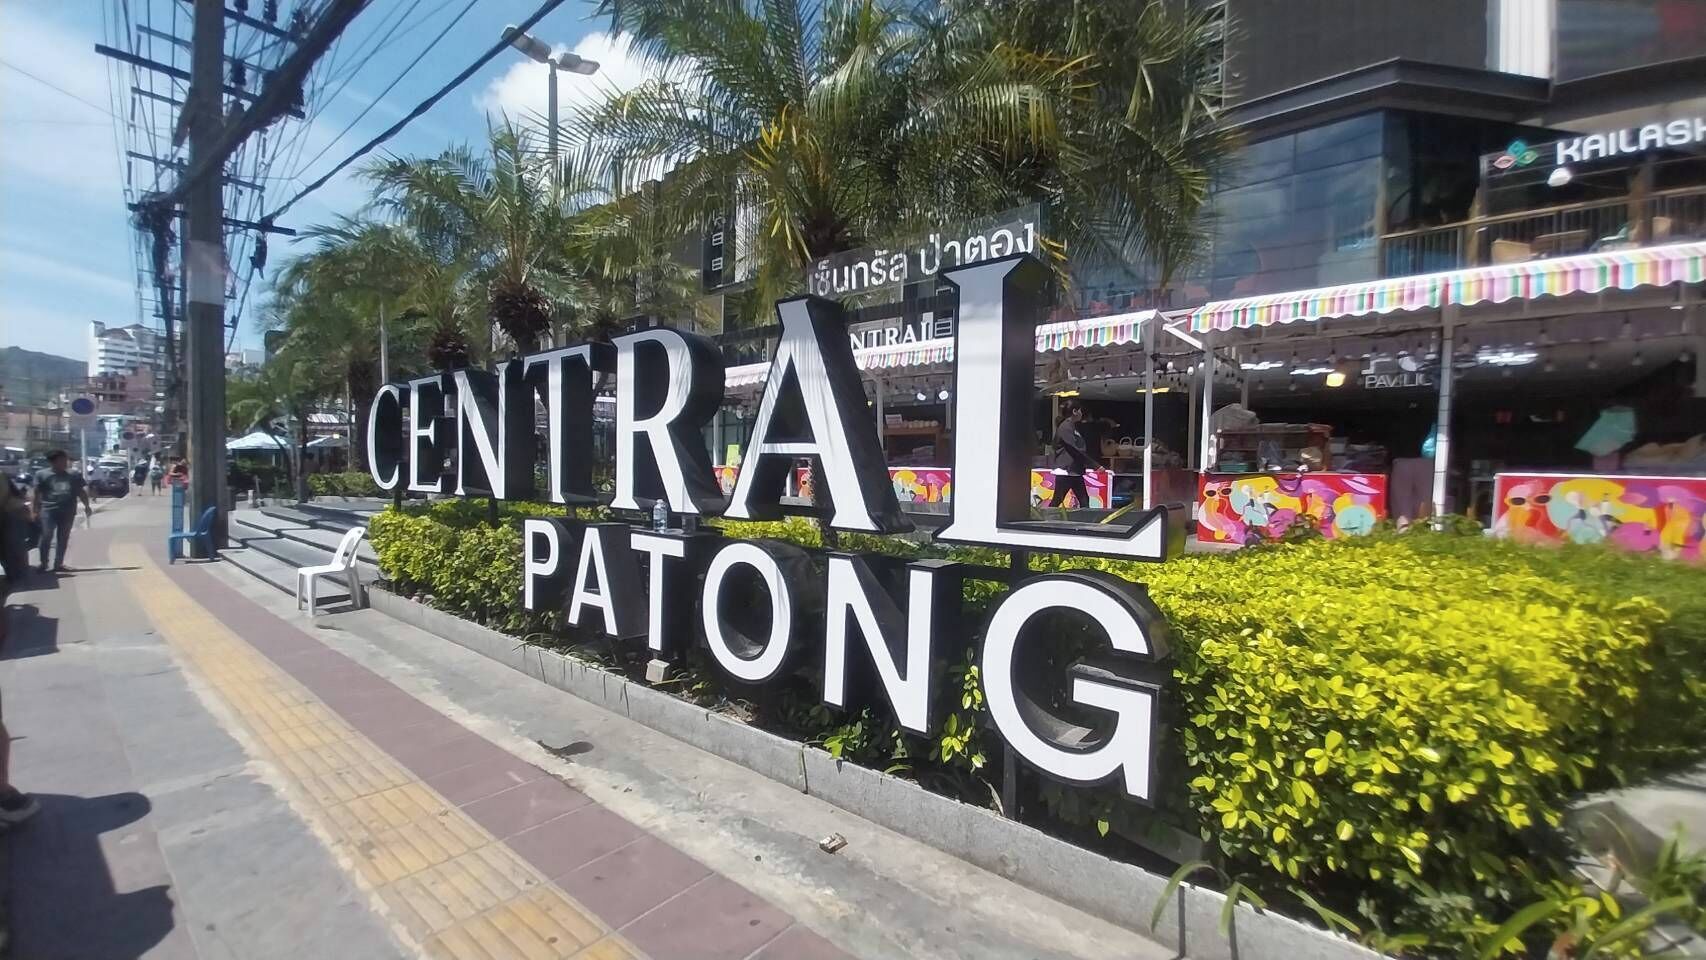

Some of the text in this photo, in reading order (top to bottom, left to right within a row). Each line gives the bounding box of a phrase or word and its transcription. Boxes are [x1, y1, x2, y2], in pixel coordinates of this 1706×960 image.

[920, 222, 1034, 275] ป่าตอง
[366, 256, 1166, 560] CENTRAL
[523, 518, 1157, 801] PATONG
